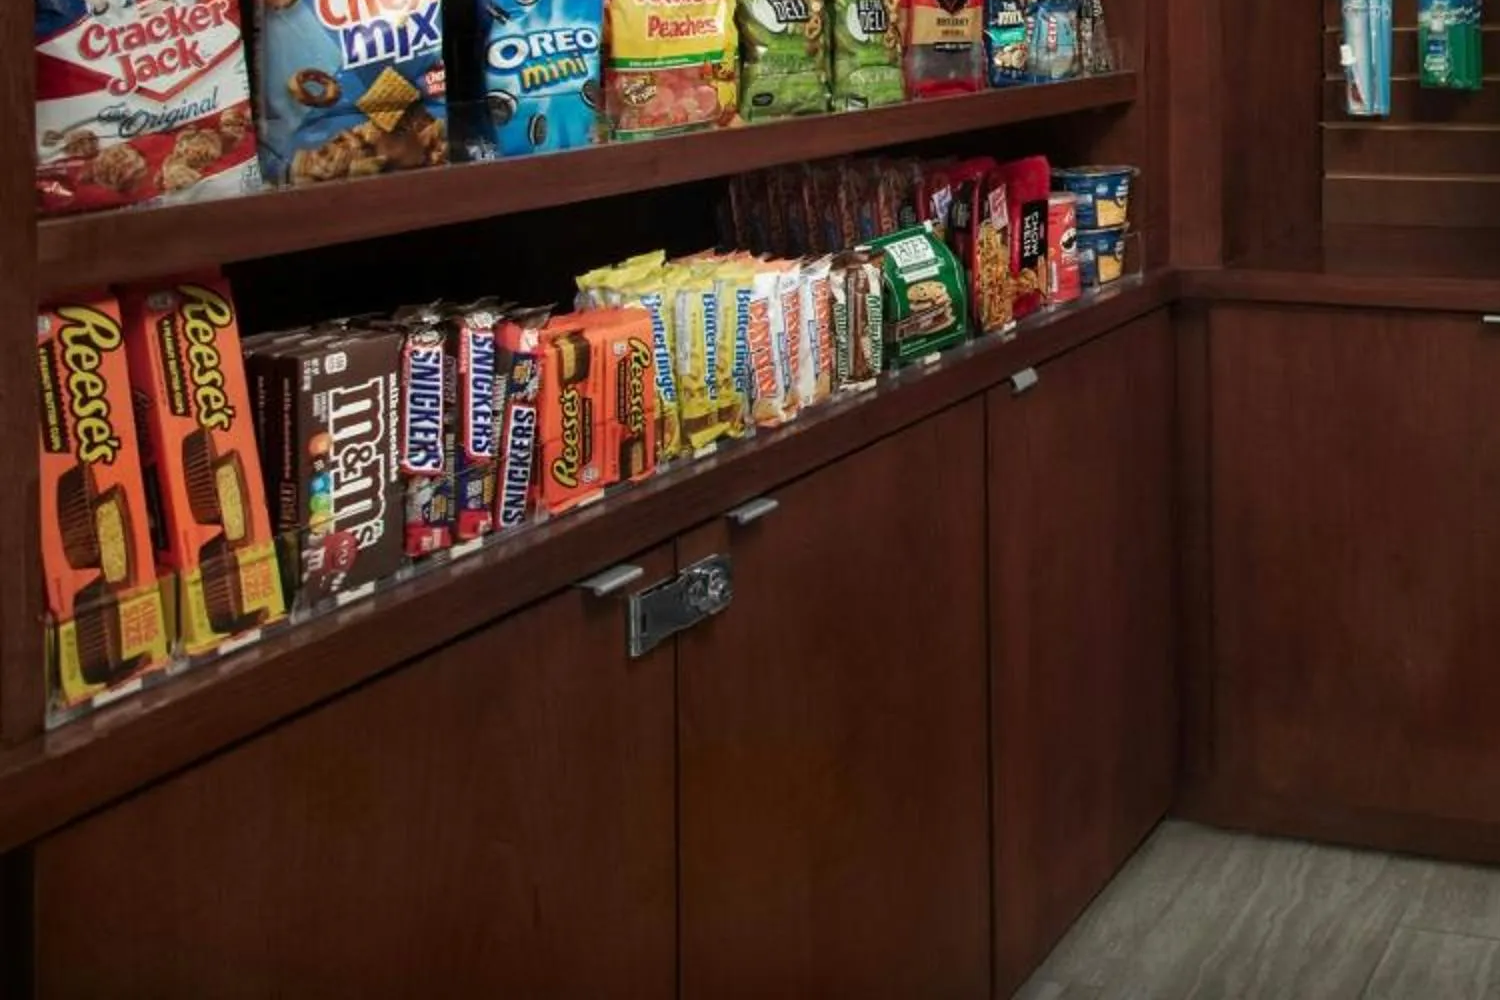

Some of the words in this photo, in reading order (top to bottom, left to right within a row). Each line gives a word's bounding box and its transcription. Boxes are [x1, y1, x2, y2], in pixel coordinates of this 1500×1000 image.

[106, 36, 204, 95] Jack
[488, 28, 599, 70] OREO
[521, 56, 589, 92] mini
[647, 14, 719, 39] Peaches
[118, 86, 219, 138] Original
[40, 355, 52, 389] PEANUT
[56, 304, 122, 466] Reese's
[179, 284, 235, 434] Reese's
[407, 347, 443, 471] SNICKERS
[470, 330, 494, 456] SNICKERS
[628, 337, 650, 437] Reese's
[501, 406, 536, 526] SNICKERS
[553, 385, 580, 488] Reese's
